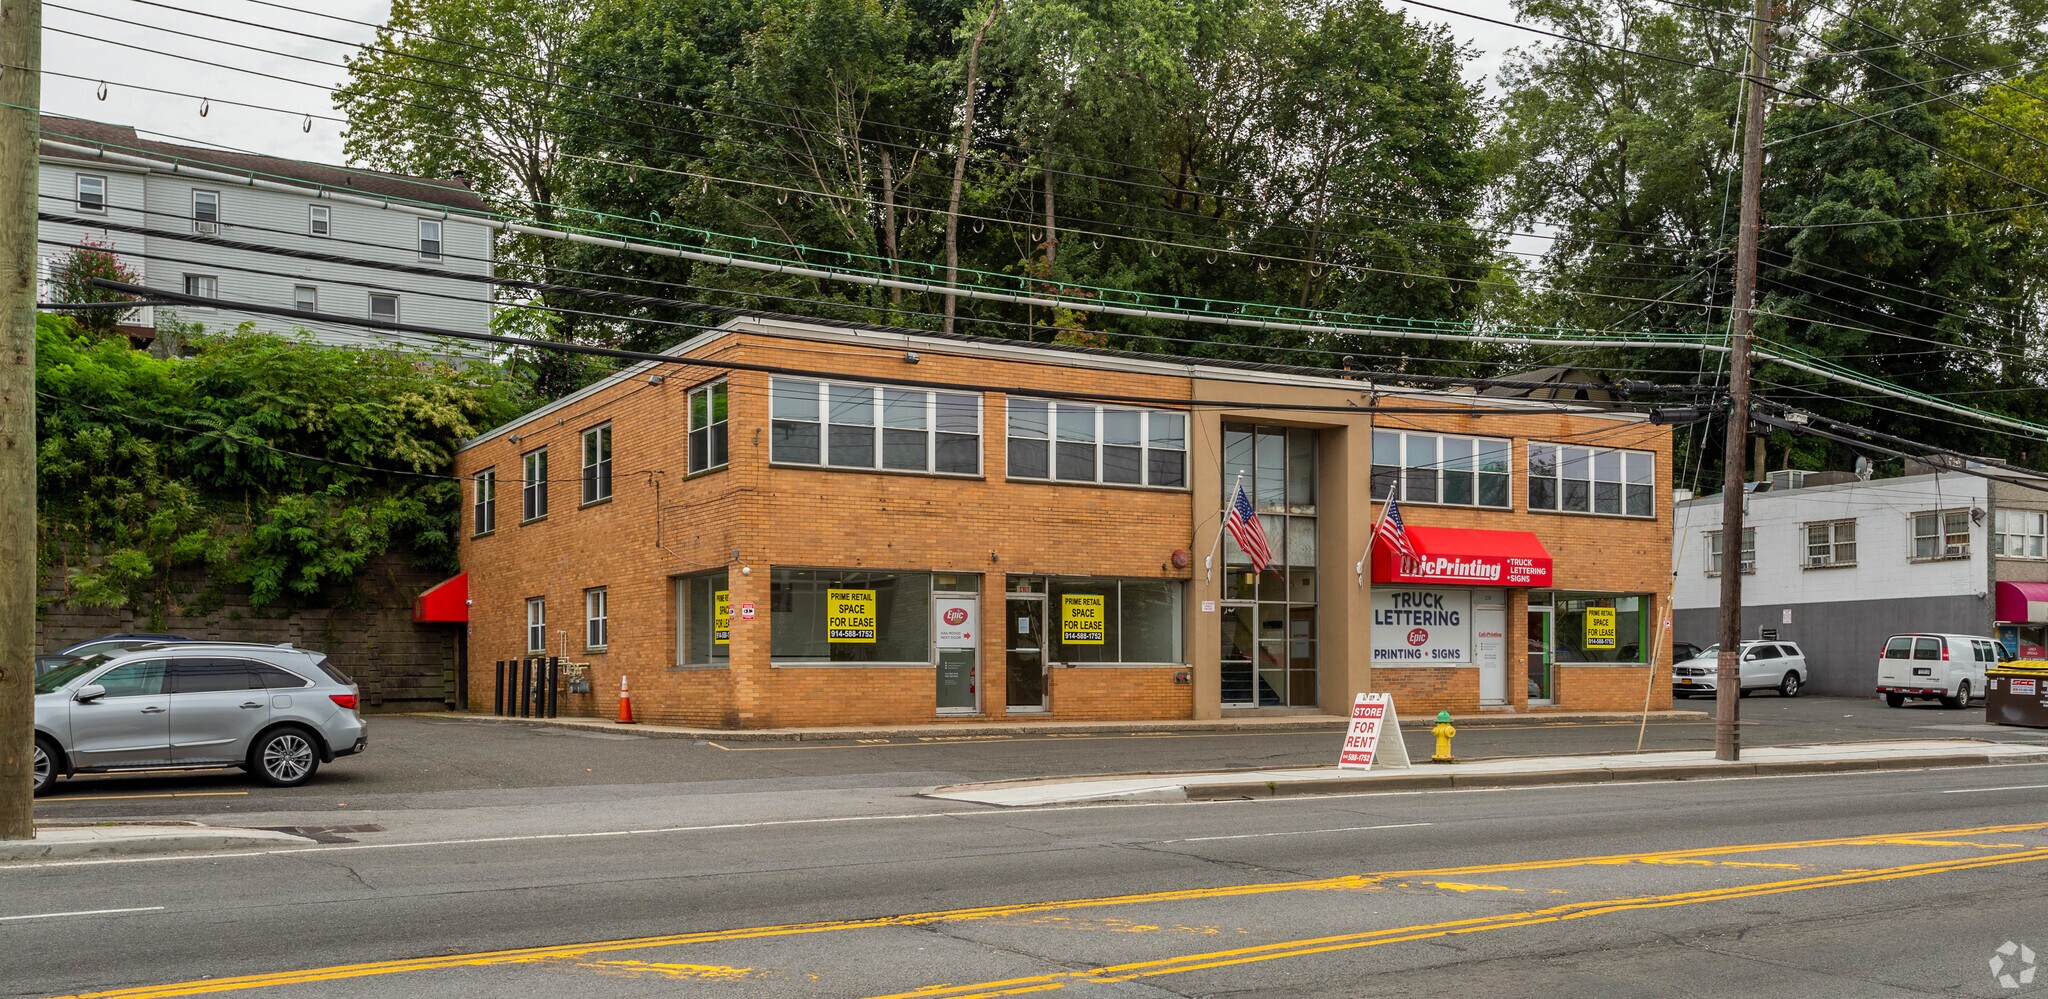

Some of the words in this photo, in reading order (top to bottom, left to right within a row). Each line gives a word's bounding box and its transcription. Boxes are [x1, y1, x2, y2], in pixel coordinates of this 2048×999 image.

[1510, 558, 1533, 567] TRUCK
[1510, 566, 1546, 575] LETTERING
[1510, 574, 1531, 583] SIGNS
[1392, 592, 1444, 610] TRUCK
[838, 604, 865, 614] SPACE
[1072, 608, 1094, 618] SPACE
[947, 610, 964, 622] Epic
[1375, 610, 1460, 626] LETTERING
[830, 618, 846, 627] FOR
[848, 618, 874, 627] LEASE
[1064, 620, 1078, 630] FOR
[1080, 621, 1102, 630] LEASE
[1410, 630, 1426, 644] Epic
[1374, 649, 1421, 660] PRINTING
[1432, 649, 1460, 659] SIGNS
[1354, 708, 1382, 716] STORE
[1354, 722, 1374, 733] FOR
[1346, 736, 1375, 748] RENT
